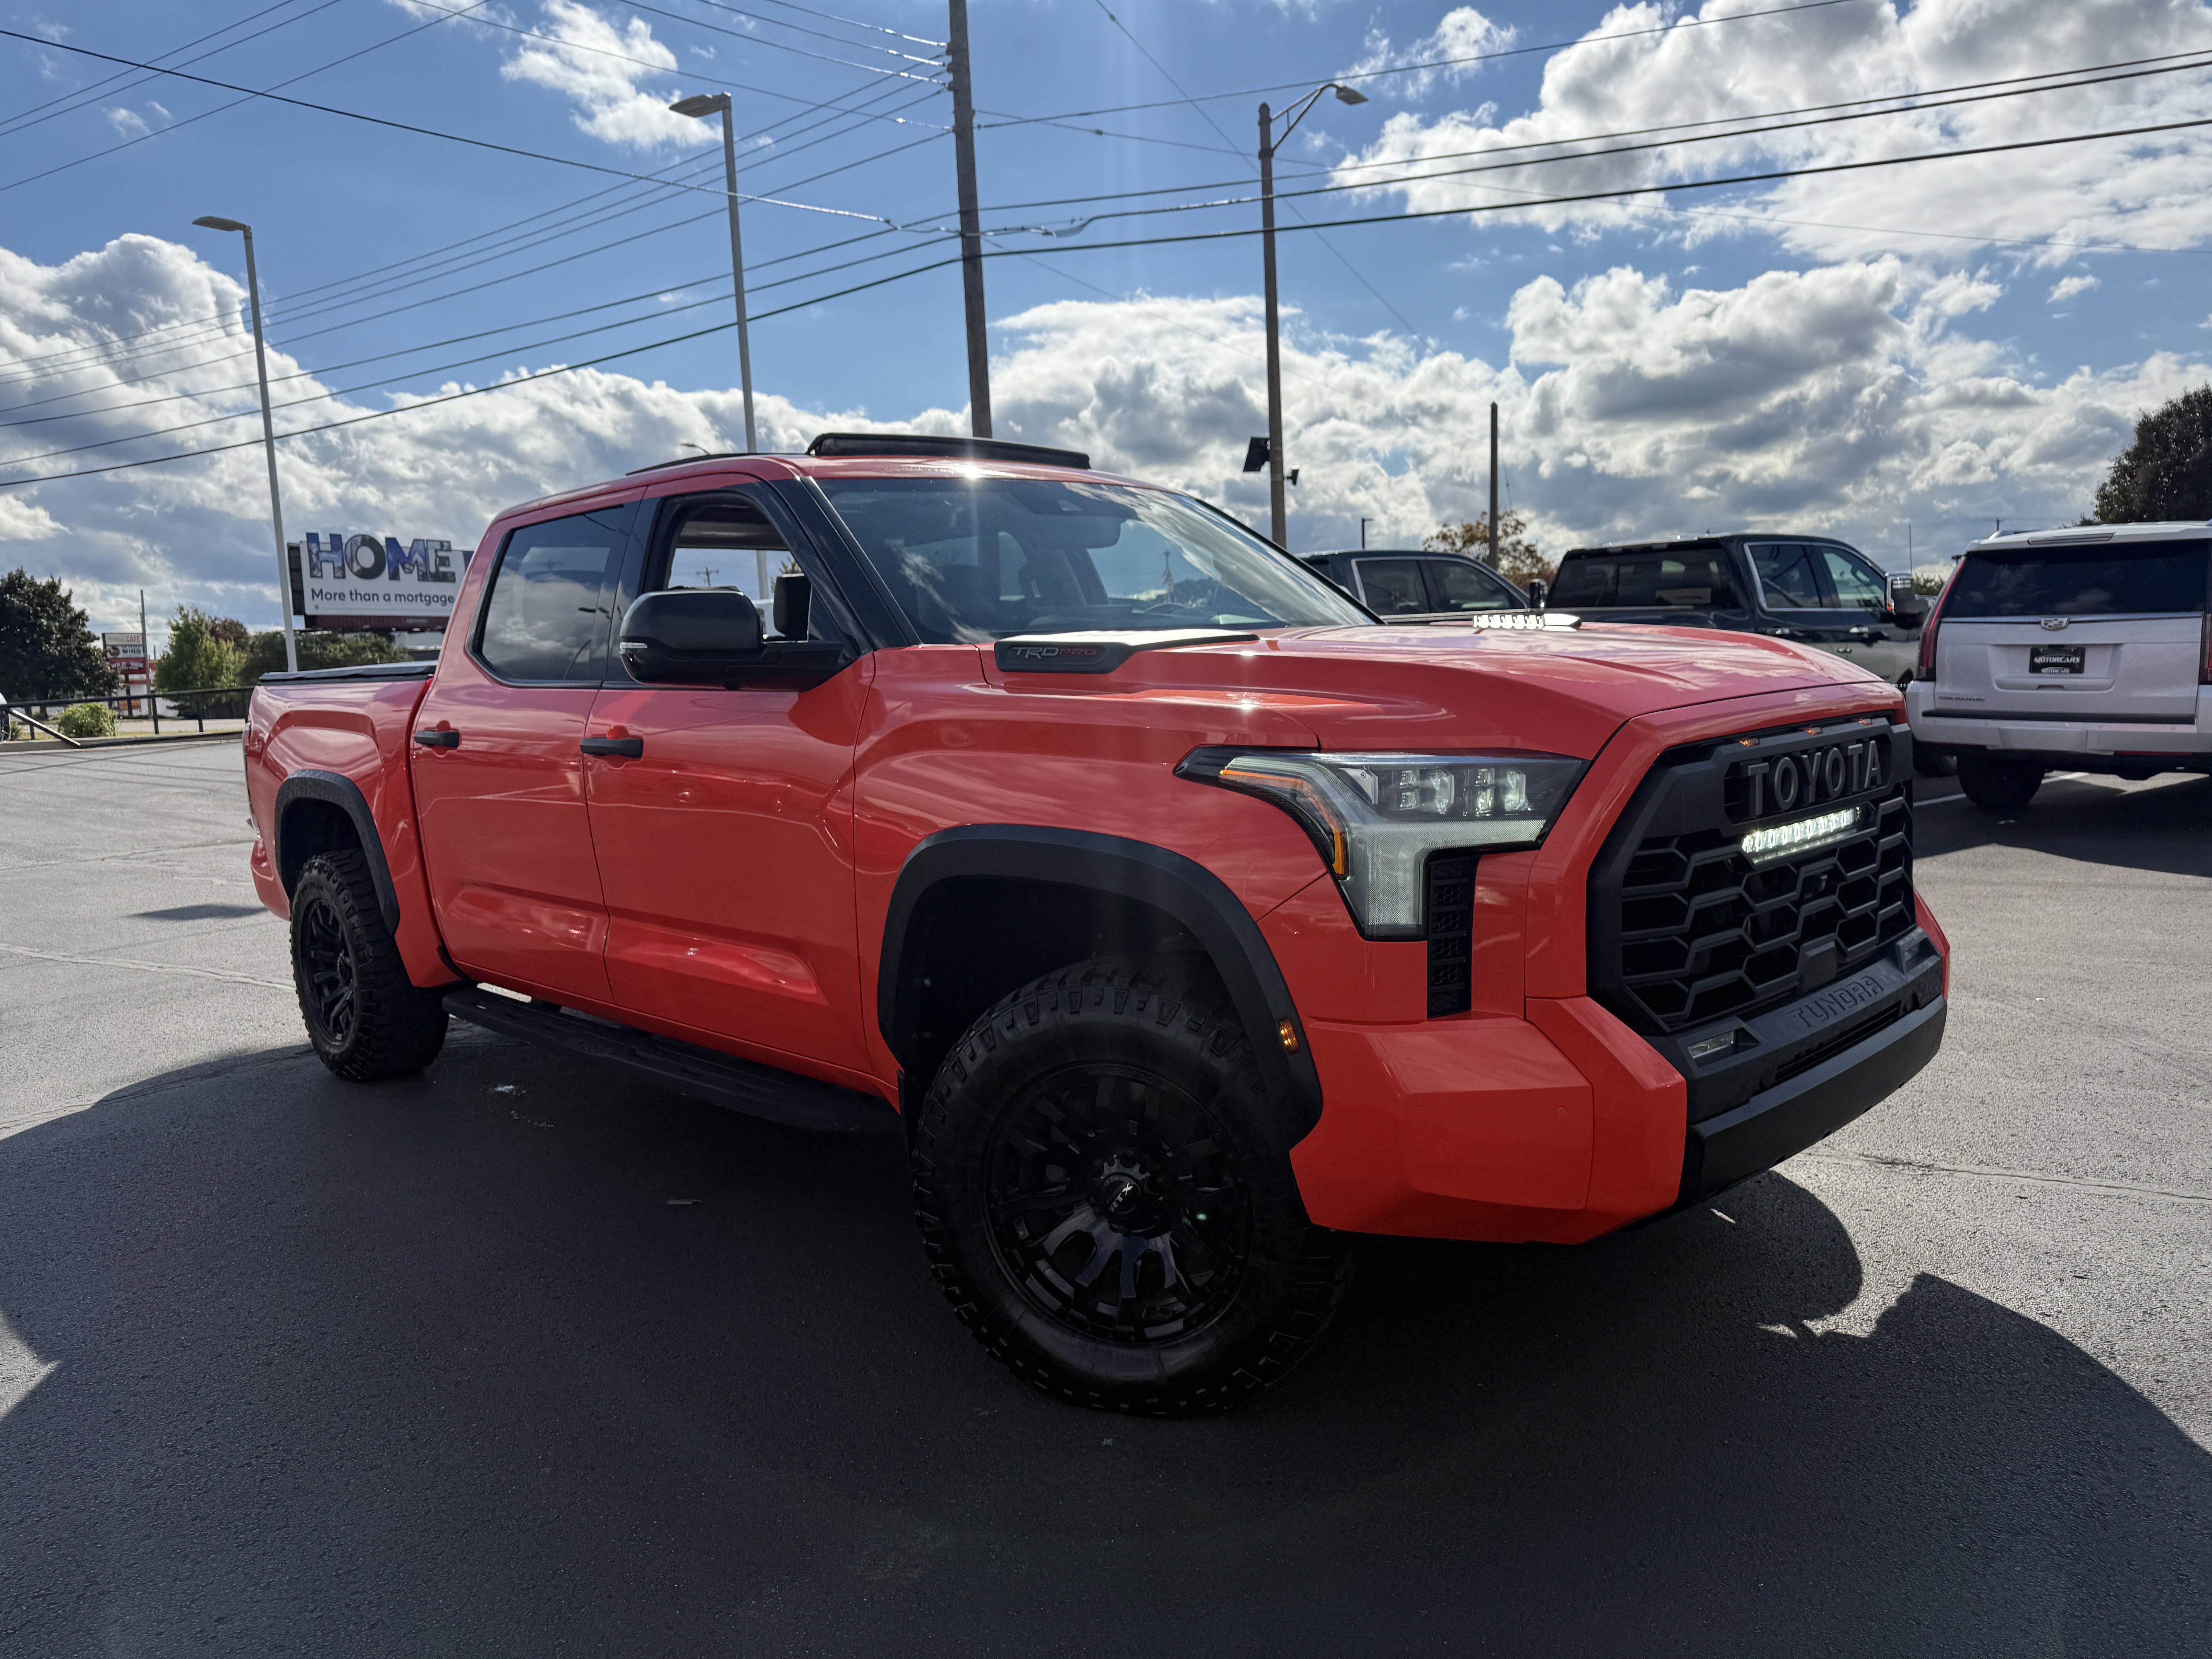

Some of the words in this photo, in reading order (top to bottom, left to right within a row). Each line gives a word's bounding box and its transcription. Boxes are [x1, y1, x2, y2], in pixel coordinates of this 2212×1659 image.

[306, 532, 456, 582] HOME
[311, 588, 345, 601] More
[349, 589, 379, 602] than
[383, 593, 391, 602] a
[394, 592, 454, 606] mortgage
[1013, 647, 1059, 659] TRD
[1059, 648, 1097, 656] PRO
[1748, 740, 1881, 816] TOYOTA
[1787, 975, 1884, 1027] TUNDRA
[1109, 1182, 1134, 1213] RTX
